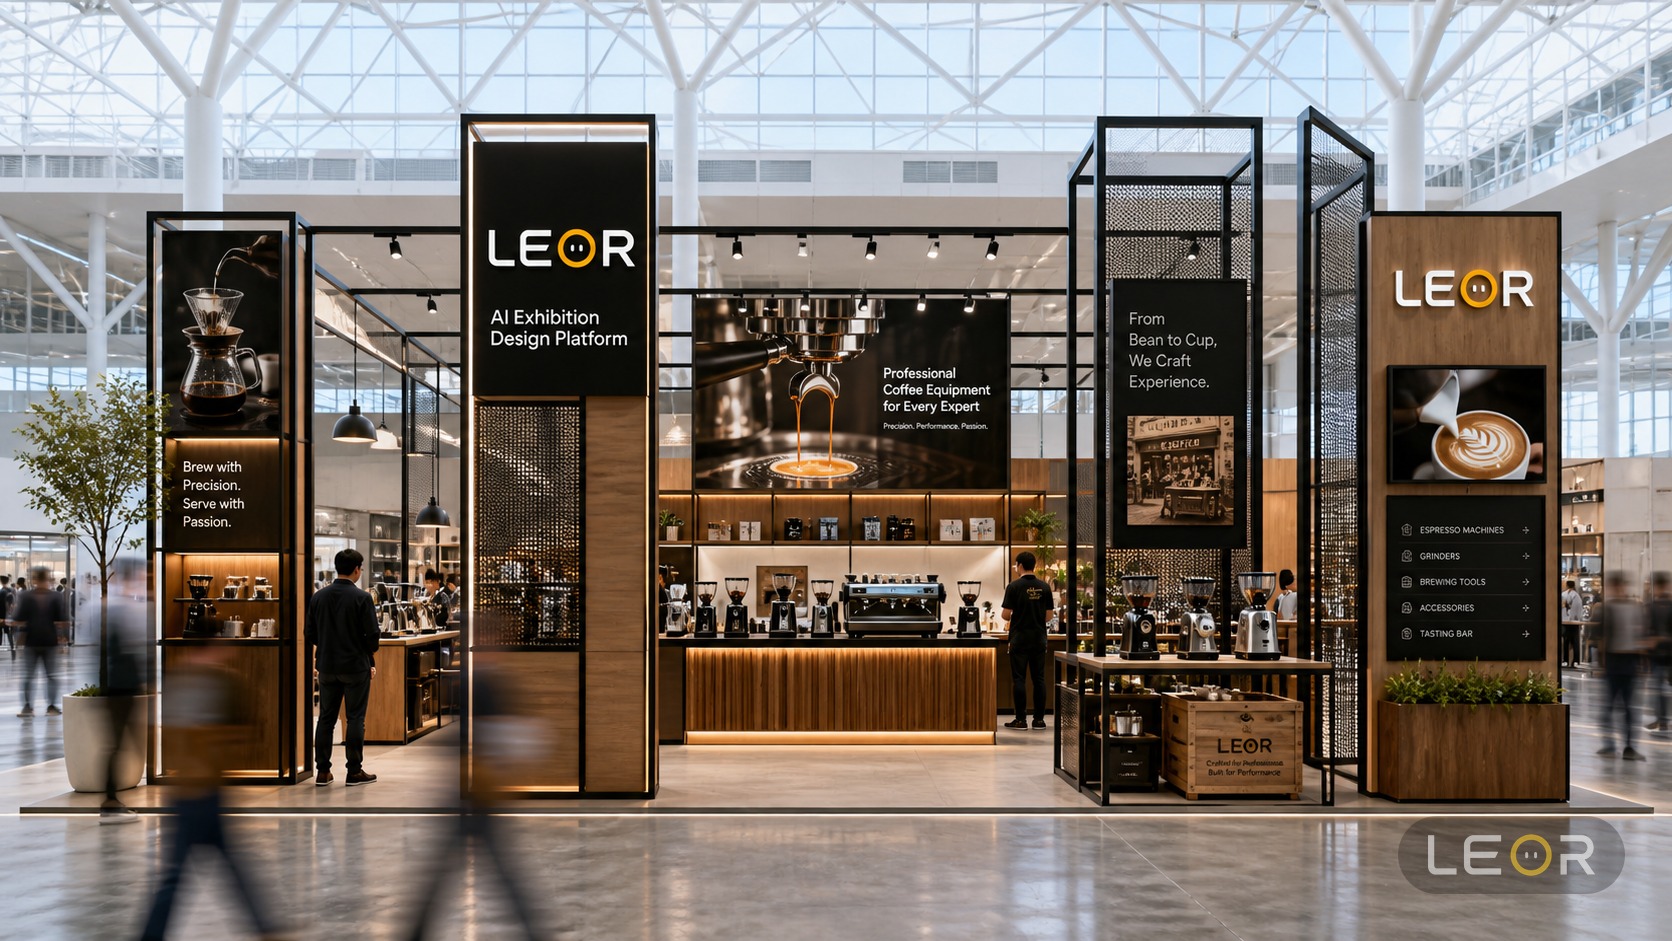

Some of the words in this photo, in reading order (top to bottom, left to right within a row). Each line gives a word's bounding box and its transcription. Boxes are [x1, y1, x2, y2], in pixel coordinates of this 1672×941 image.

[488, 228, 636, 268] LEOR
[1394, 269, 1534, 308] LEOR
[490, 309, 509, 325] AI
[514, 308, 600, 325] Exhibition
[1129, 311, 1165, 326] From
[490, 330, 550, 350] Design
[555, 330, 628, 347] Platform
[1129, 332, 1164, 347] Bean
[1167, 334, 1182, 347] to
[1185, 332, 1217, 350] Cup,
[1129, 353, 1152, 368] We
[1155, 353, 1192, 368] Craft
[883, 366, 956, 379] Professional
[1129, 374, 1210, 392] Experience.
[883, 383, 924, 396] Coffee
[926, 383, 991, 399] Equipment
[883, 400, 901, 412] for
[903, 400, 938, 415] Every
[940, 400, 980, 415] Expert
[883, 422, 915, 430] Precision.
[916, 422, 960, 430] Performance.
[183, 460, 214, 473] Brew
[216, 460, 242, 473] with
[183, 478, 241, 491] Precision.
[183, 497, 217, 510] Serve
[219, 497, 245, 510] with
[183, 515, 232, 528] Passion.
[1420, 525, 1461, 535] ESPRESSO
[1462, 525, 1505, 535] MACHINES
[1419, 552, 1461, 561] GRINDERS
[1419, 577, 1458, 586] BREWING
[1459, 577, 1486, 586] TOOLS
[1419, 603, 1475, 612] ACCESSORIES
[1420, 629, 1455, 638] TASTING
[1456, 629, 1473, 638] BAR
[1217, 738, 1272, 754] LEOR
